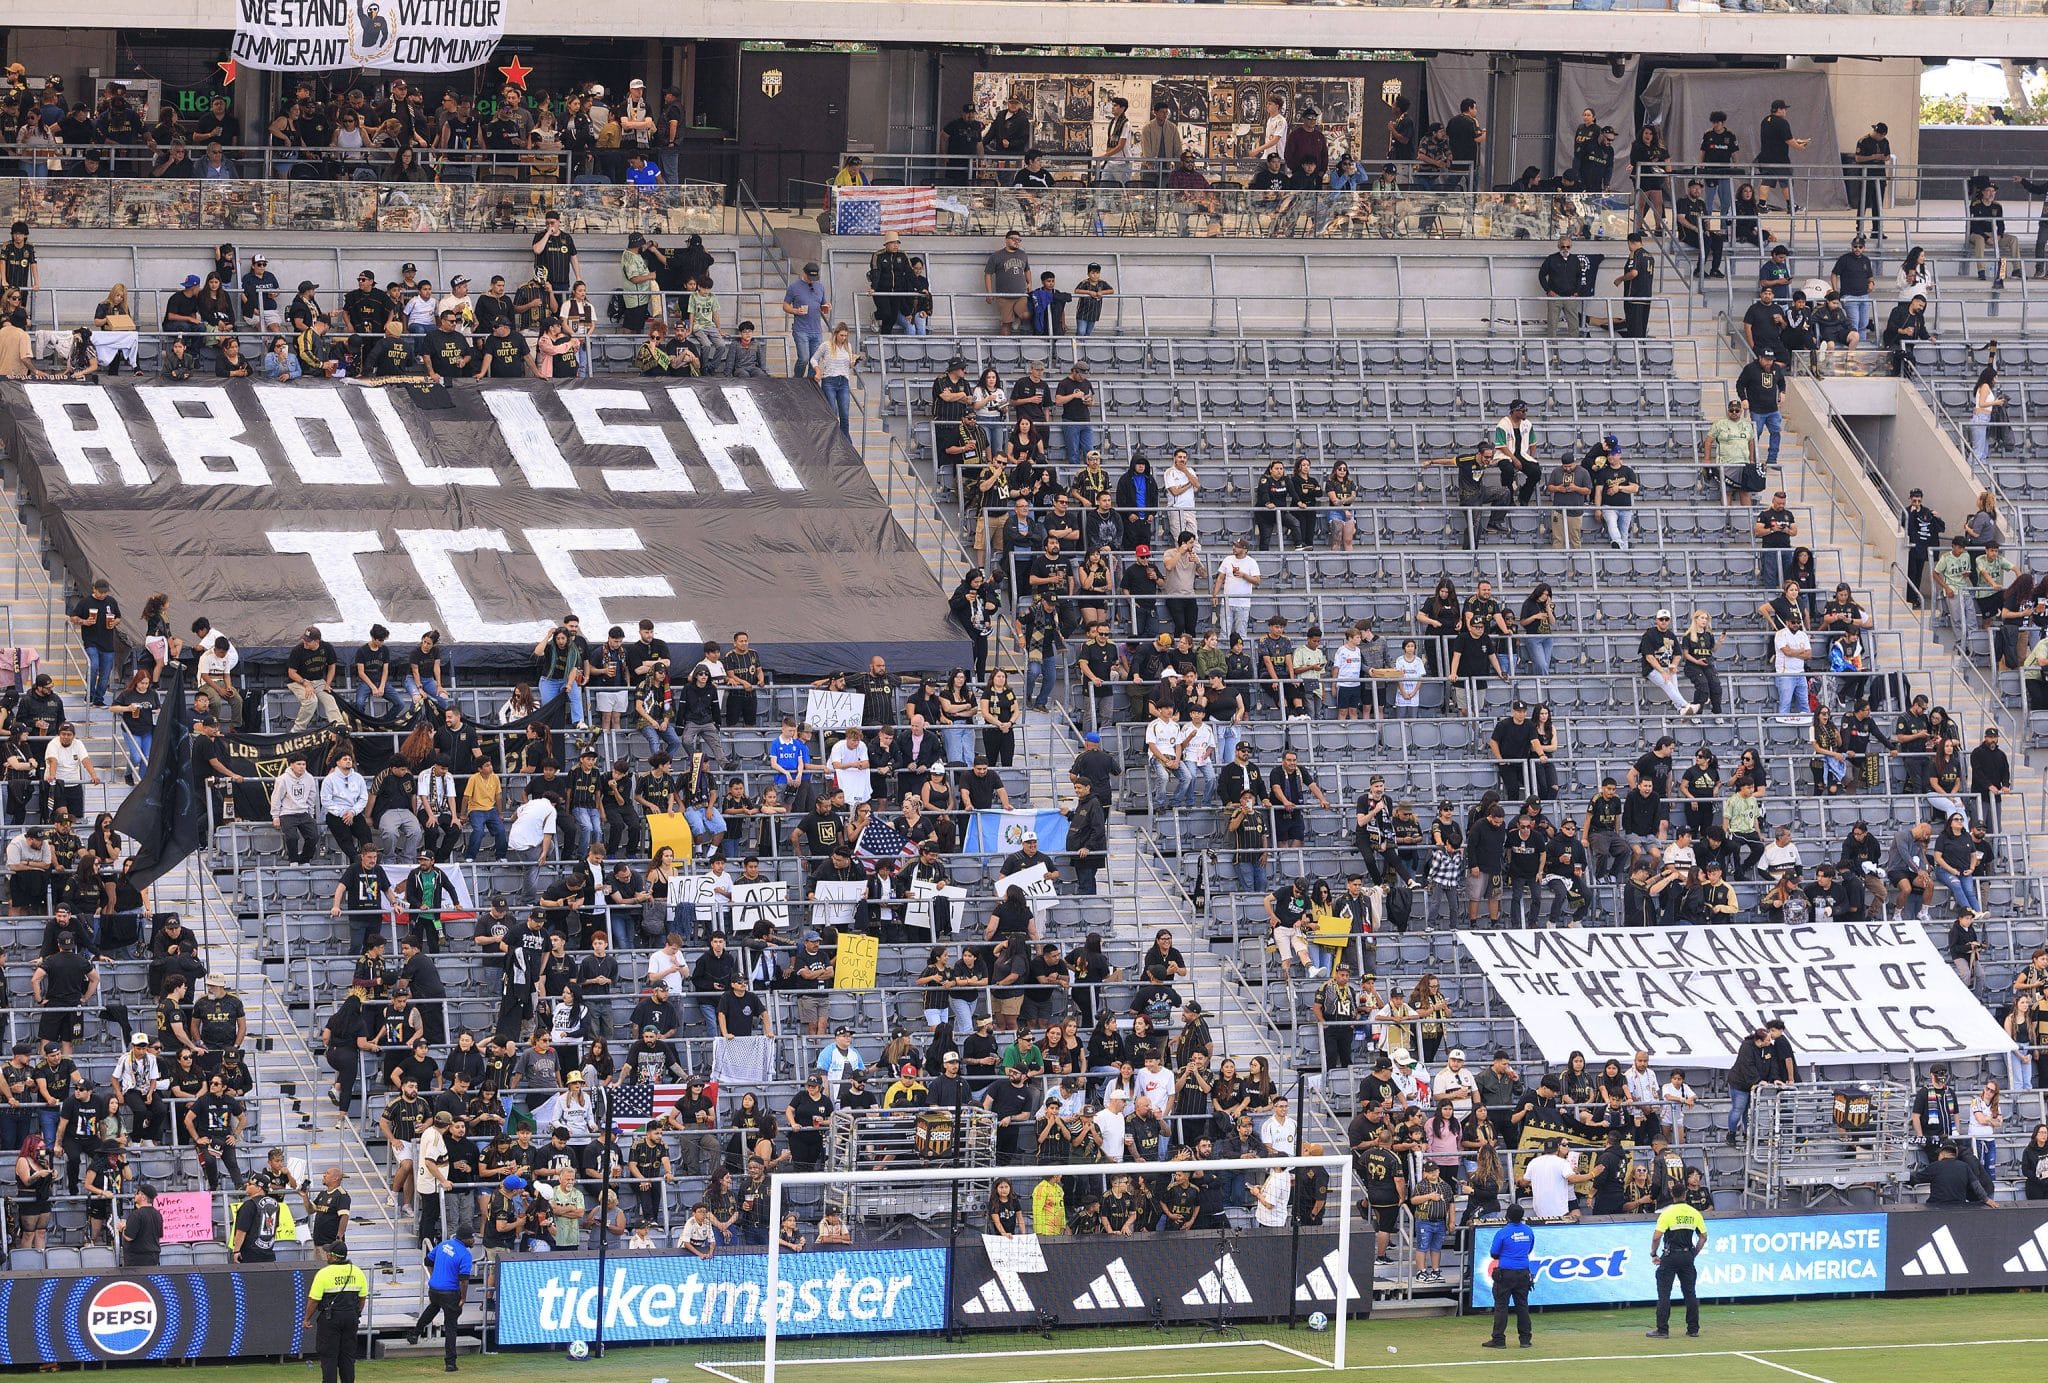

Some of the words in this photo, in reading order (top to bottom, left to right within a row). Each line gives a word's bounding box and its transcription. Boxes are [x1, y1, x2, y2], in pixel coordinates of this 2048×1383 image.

[281, 0, 347, 27] STAND
[400, 0, 457, 26] WITH
[459, 0, 500, 26] OUR
[234, 32, 349, 66] IMMIGRANT
[393, 36, 500, 64] COMMUNITY
[441, 349, 453, 357] OUT
[502, 341, 512, 349] ICE
[509, 348, 517, 356] OF
[400, 351, 408, 359] OF
[15, 384, 803, 493] ABOLISH
[264, 526, 702, 644] ICE
[811, 692, 853, 711] VIVA
[811, 716, 847, 728] RAZA
[826, 710, 838, 719] LA
[229, 742, 258, 758] LOS
[267, 763, 279, 772] ICE
[740, 887, 788, 922] ARE
[847, 936, 874, 957] ICE
[1469, 927, 1837, 969] IMMIGRANTS
[1844, 922, 1916, 947] ARE
[841, 956, 860, 968] OUT
[865, 958, 875, 968] OF
[852, 967, 867, 978] OUR
[840, 977, 872, 989] CITY
[1500, 972, 1569, 996] THE
[1571, 963, 1863, 1009] HEARTBEAT
[1879, 961, 1927, 991] OF
[207, 1013, 230, 1021] FLEX
[1566, 1010, 1693, 1056] LOS
[930, 1130, 951, 1140] 3252
[1367, 1163, 1386, 1179] 99
[1173, 1205, 1191, 1214] FLEX
[1676, 1216, 1695, 1225] SECURITY
[187, 1228, 211, 1239] DUTY
[1715, 1233, 1737, 1253] #1
[1741, 1229, 1881, 1253] TOOTHPASTE
[1488, 1248, 1628, 1283] rest
[1698, 1264, 1748, 1284] AND
[1752, 1264, 1769, 1282] IN
[1772, 1258, 1879, 1282] AMERICA
[334, 1275, 356, 1285] SECURITY
[537, 1267, 914, 1331] ticketmaster
[92, 1310, 154, 1327] PEPSI
